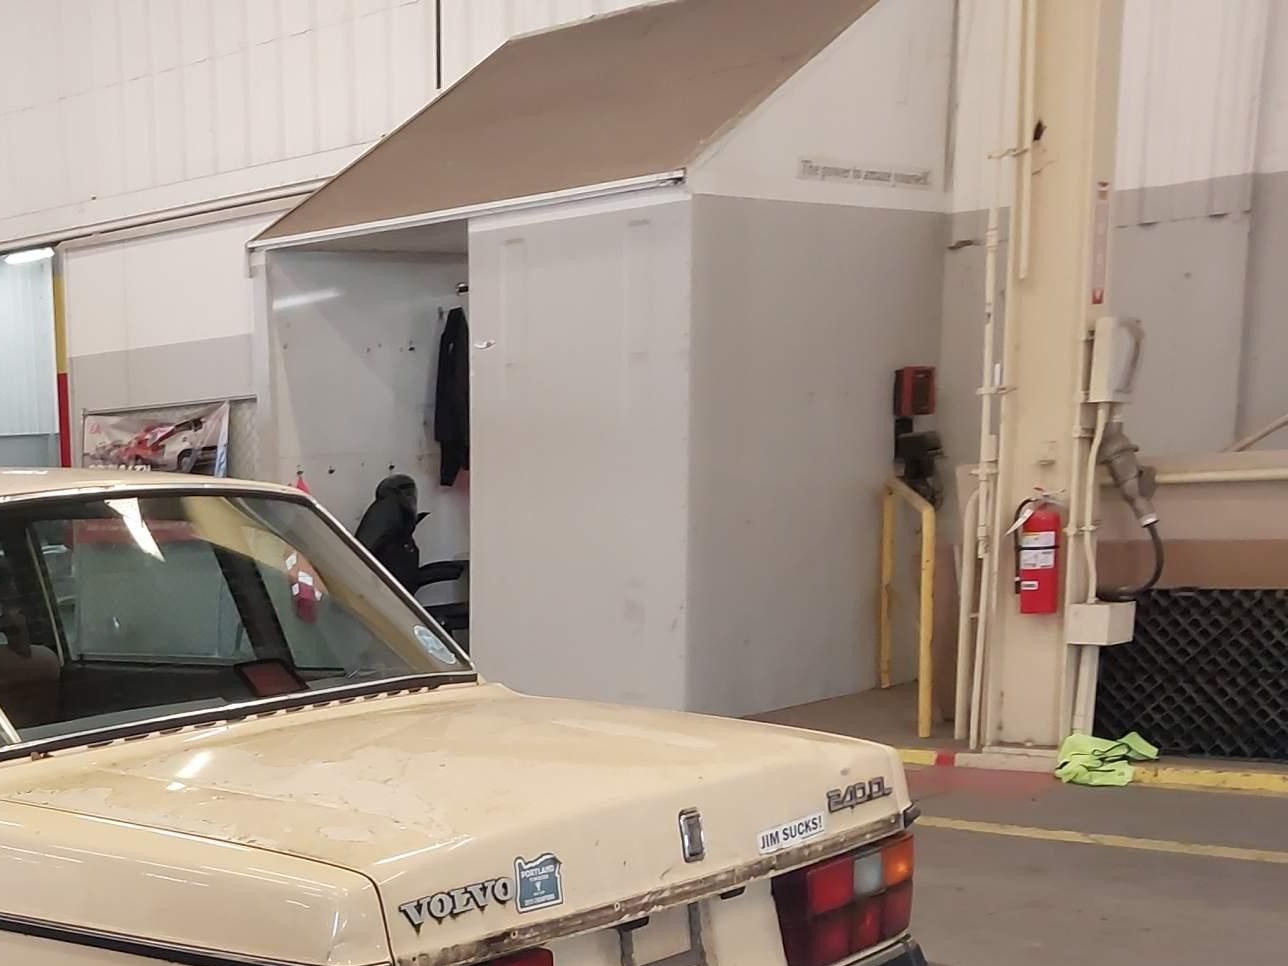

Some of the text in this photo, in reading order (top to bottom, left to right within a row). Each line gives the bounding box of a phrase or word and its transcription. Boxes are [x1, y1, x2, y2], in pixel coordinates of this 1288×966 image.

[760, 815, 823, 850] JIM SUCKS!
[398, 876, 515, 926] VOLVO
